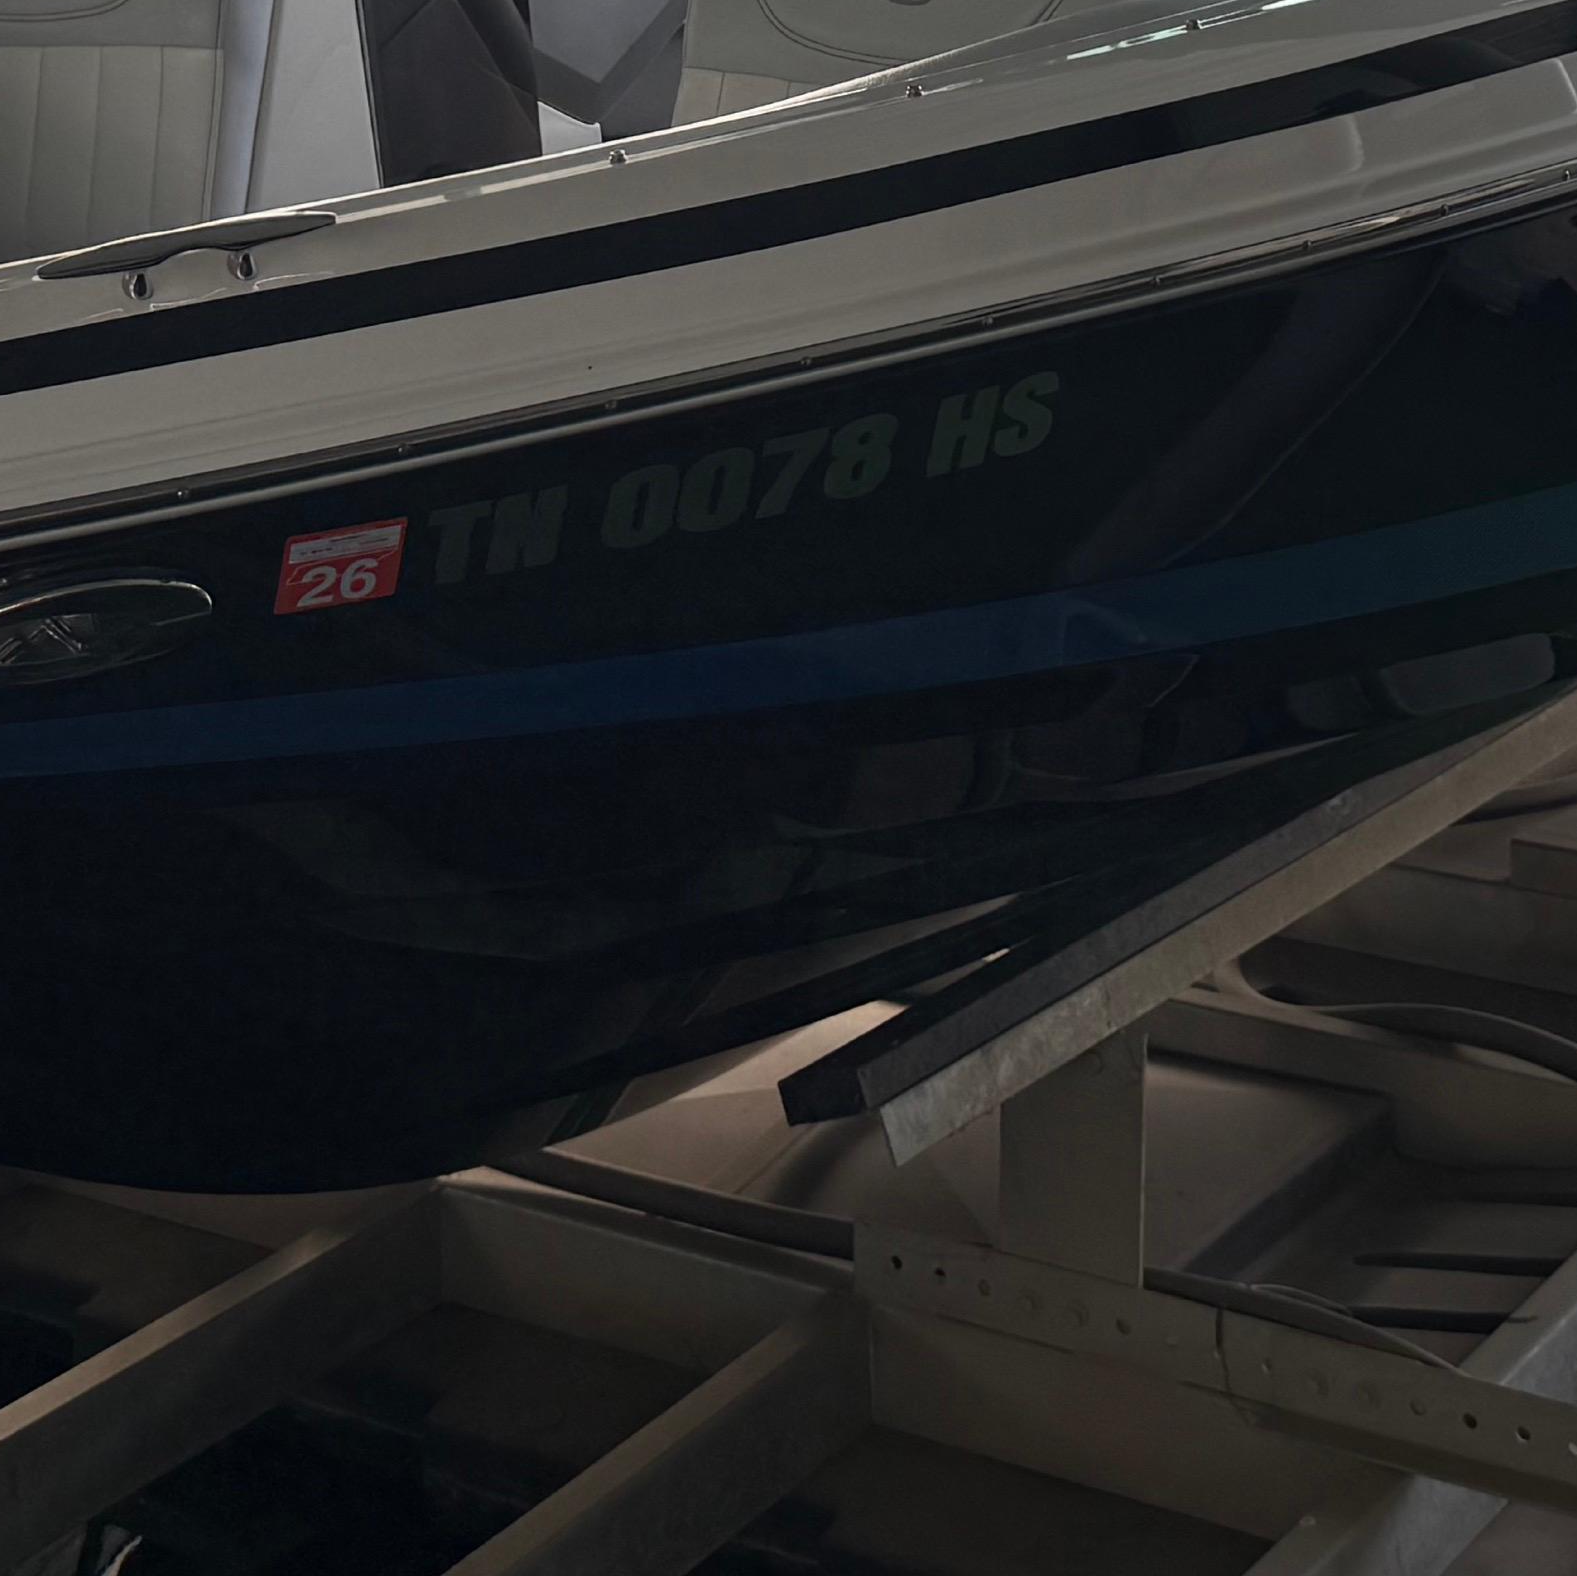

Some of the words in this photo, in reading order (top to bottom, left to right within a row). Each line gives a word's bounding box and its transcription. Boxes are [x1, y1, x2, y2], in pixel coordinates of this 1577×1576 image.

[429, 485, 569, 584] TN
[600, 413, 900, 549] 0078
[925, 370, 1061, 477] HS
[296, 557, 379, 608] 26
